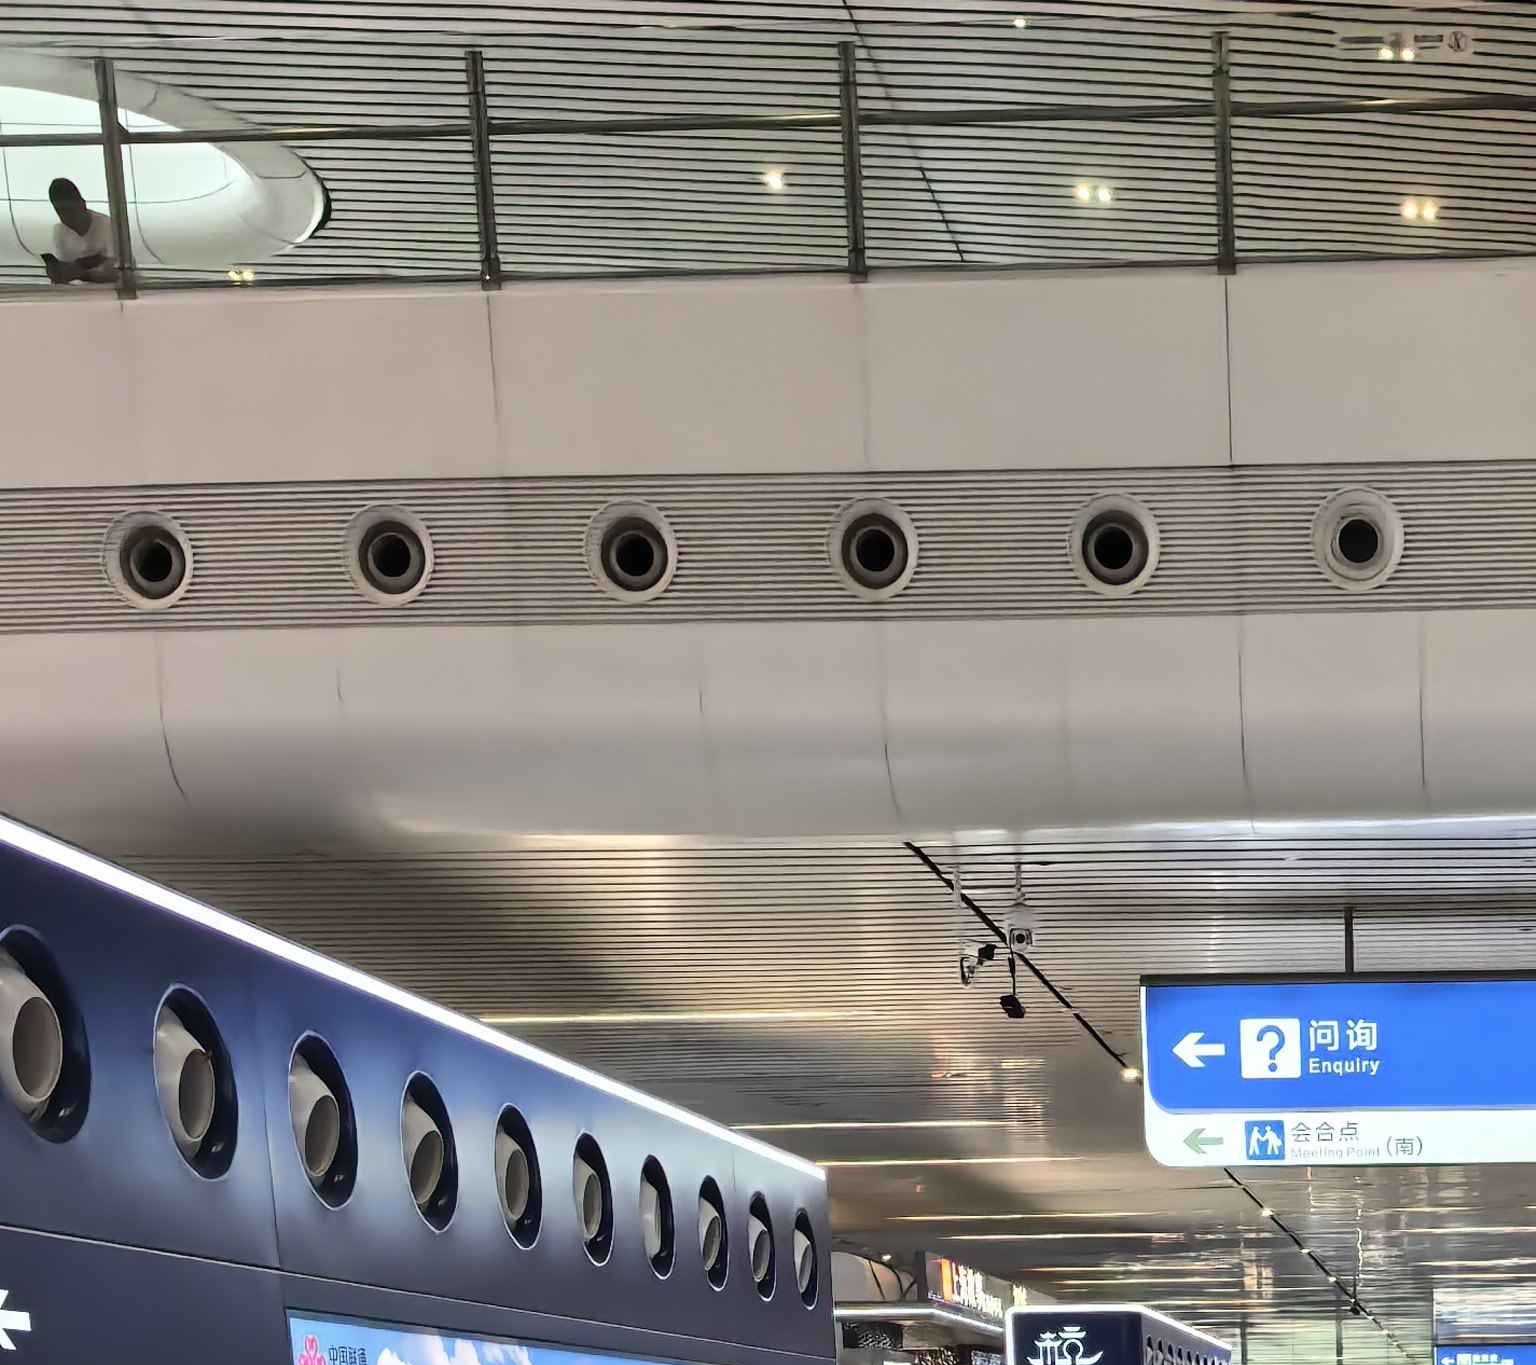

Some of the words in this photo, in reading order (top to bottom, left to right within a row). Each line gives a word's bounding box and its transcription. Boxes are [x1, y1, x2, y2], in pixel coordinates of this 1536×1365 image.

[1309, 1019, 1378, 1051] 问询
[1308, 1057, 1380, 1075] Enquiry
[1291, 1120, 1359, 1142] 会合点
